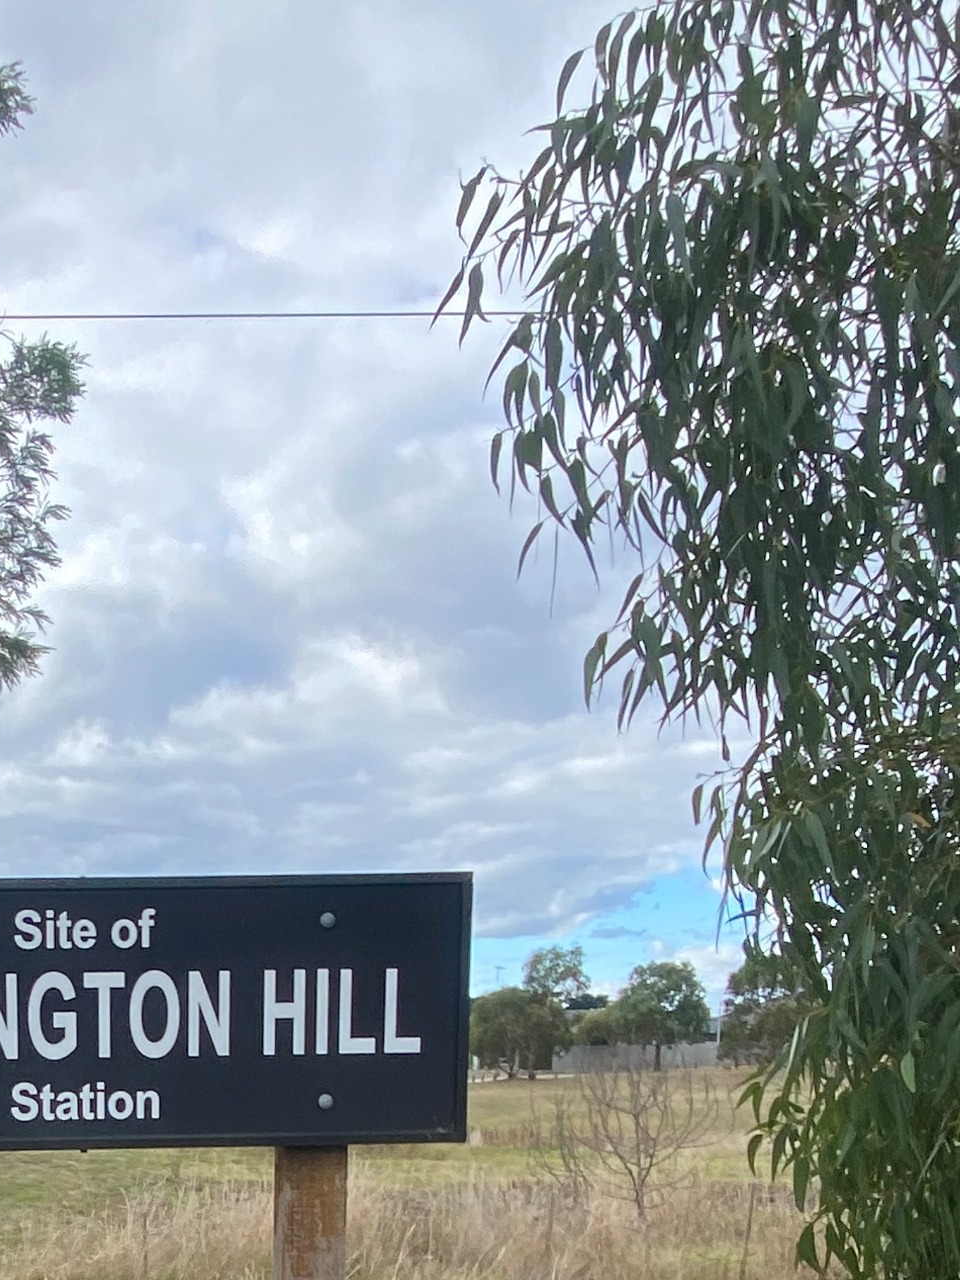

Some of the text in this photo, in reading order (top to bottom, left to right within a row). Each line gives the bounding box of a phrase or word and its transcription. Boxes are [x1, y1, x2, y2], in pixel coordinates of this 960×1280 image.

[13, 908, 156, 950] Site of
[262, 967, 422, 1056] HILL
[10, 1082, 160, 1122] Station
